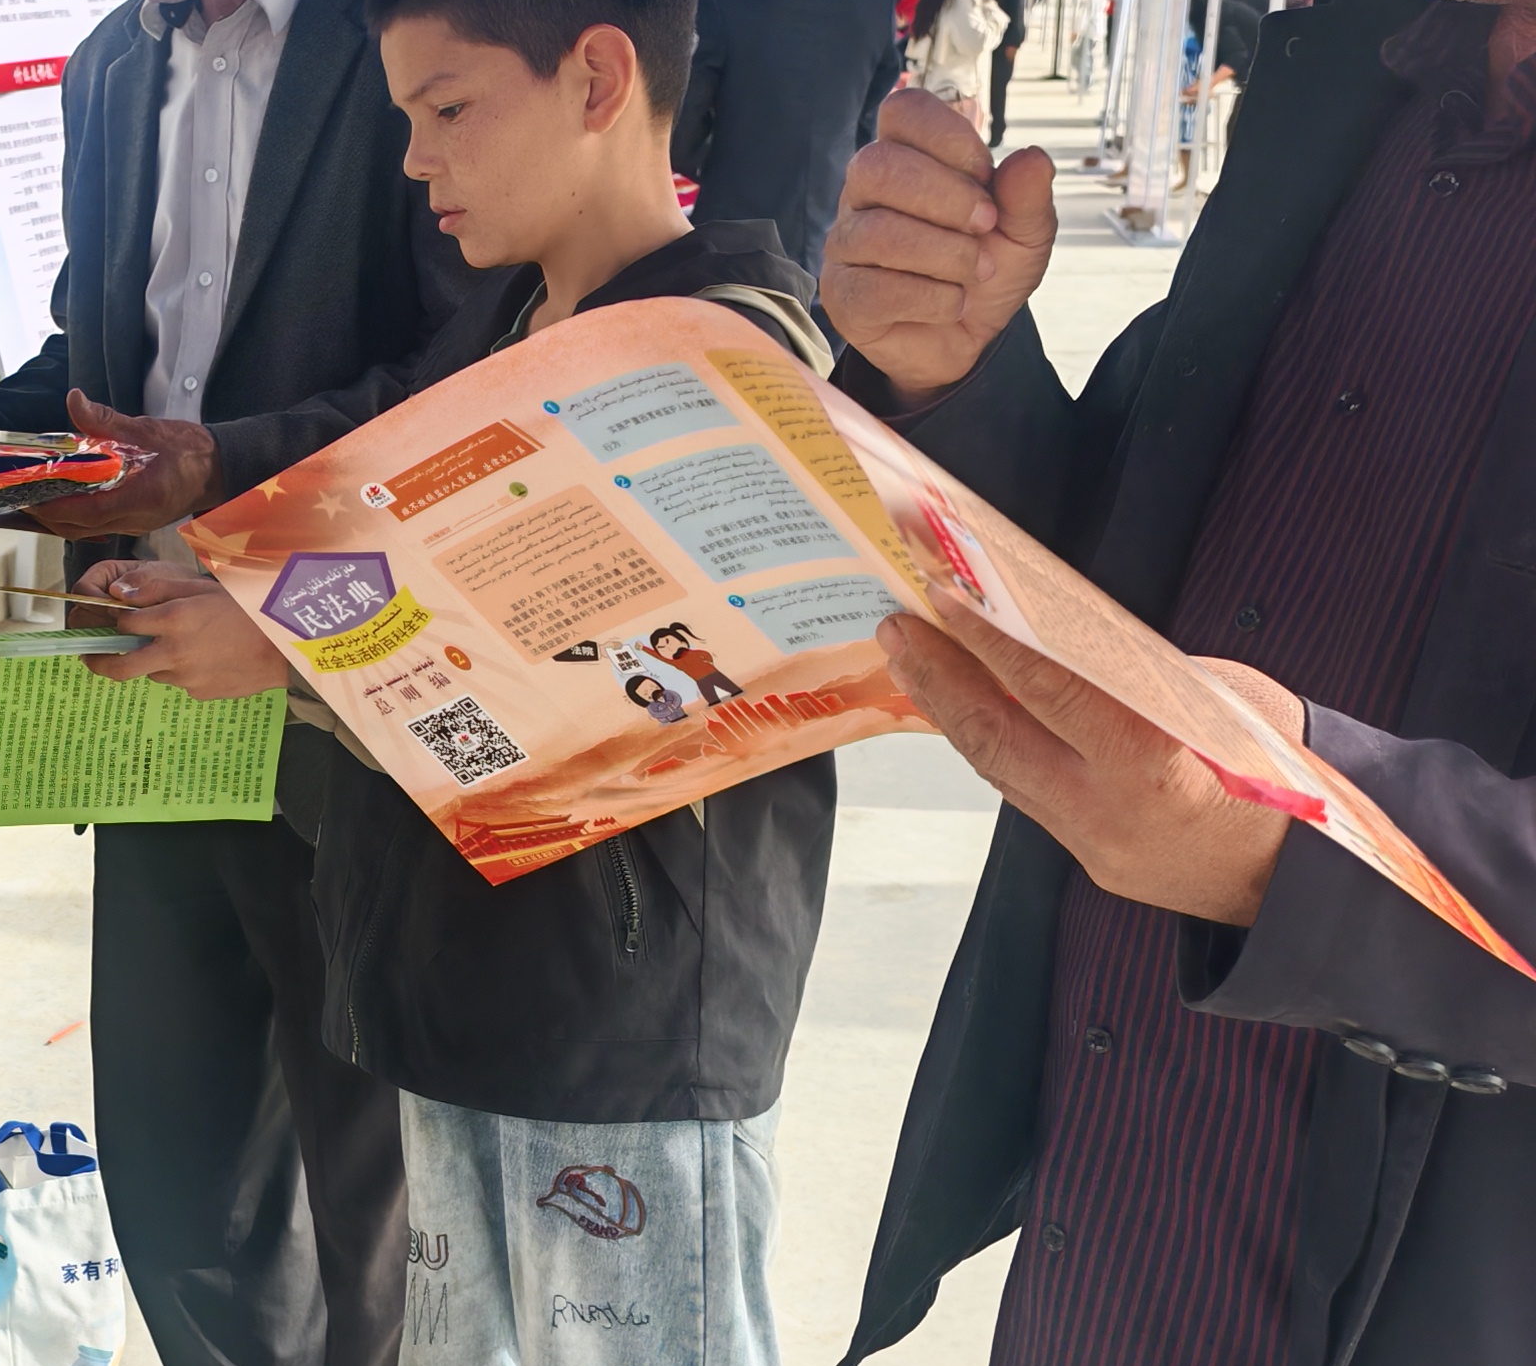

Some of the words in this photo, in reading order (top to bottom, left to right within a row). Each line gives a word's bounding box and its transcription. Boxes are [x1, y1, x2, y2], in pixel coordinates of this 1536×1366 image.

[294, 580, 384, 637] 民法典
[315, 608, 429, 671] 社会生活的百科全书
[376, 671, 451, 716] 总则编
